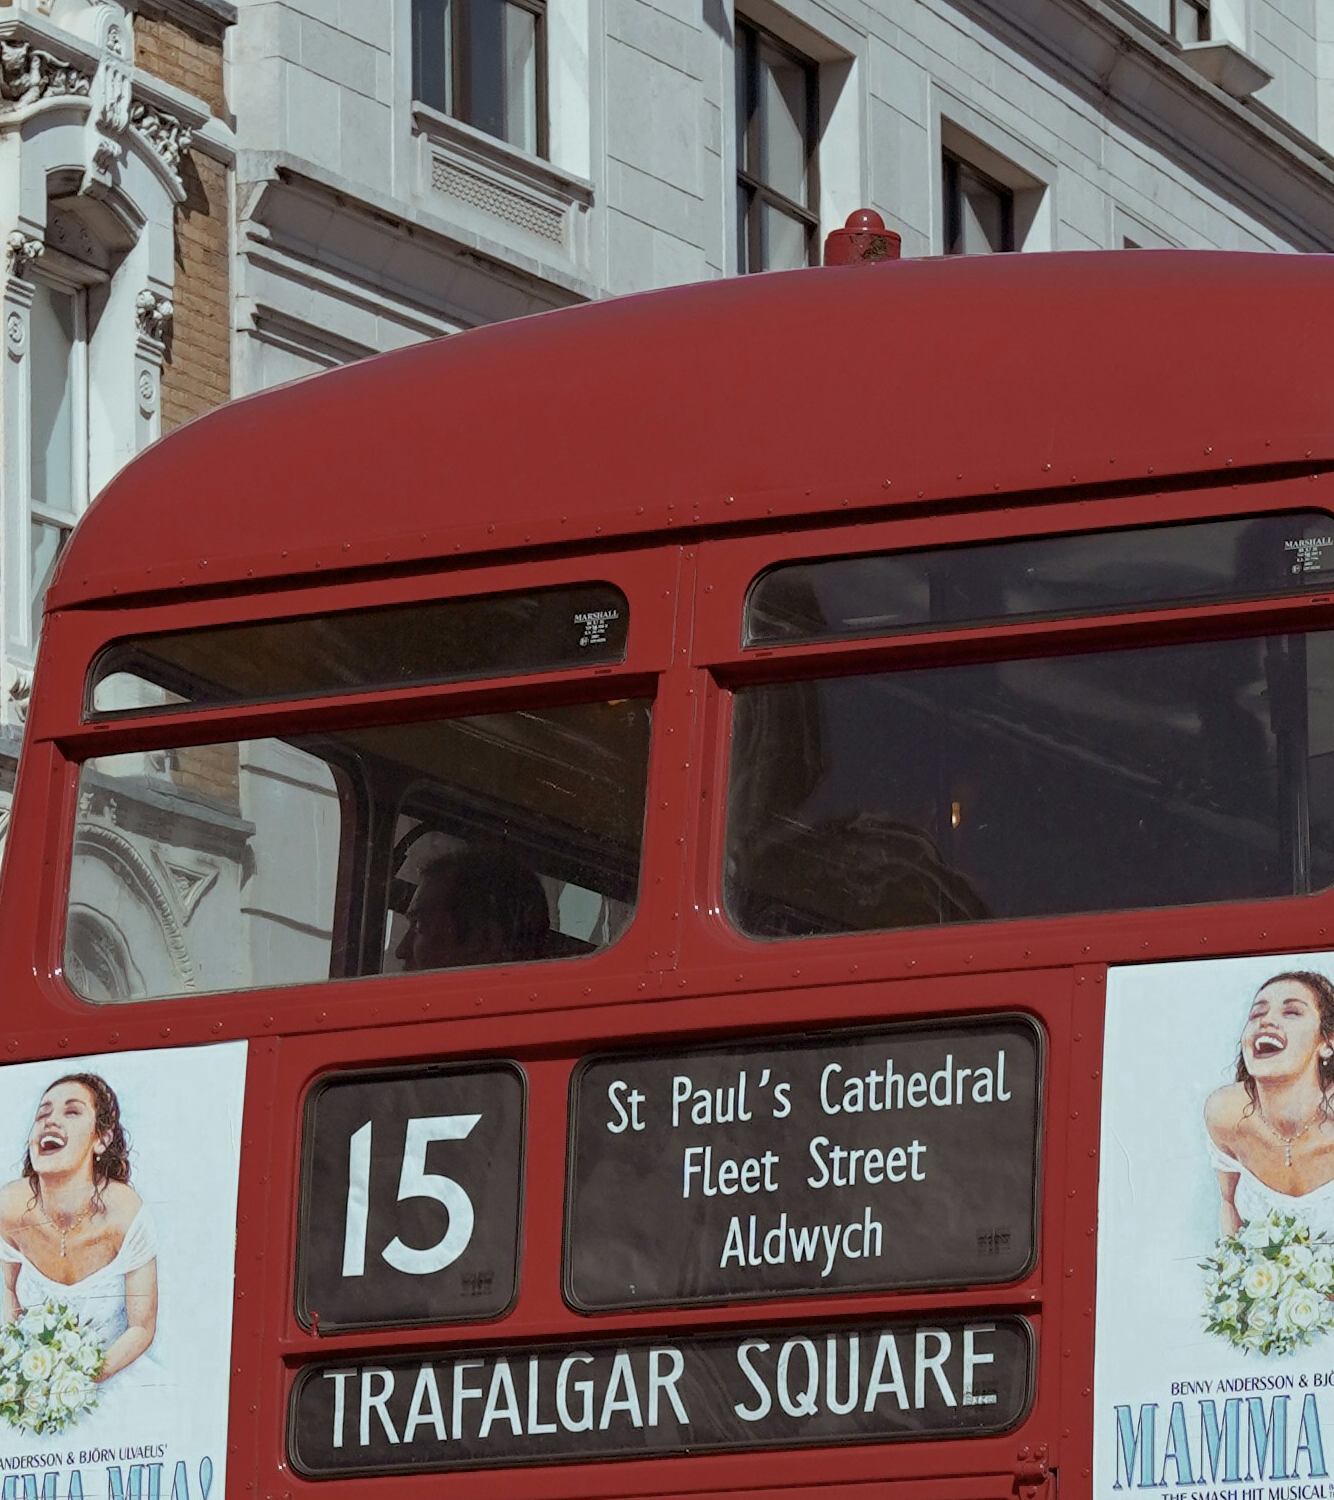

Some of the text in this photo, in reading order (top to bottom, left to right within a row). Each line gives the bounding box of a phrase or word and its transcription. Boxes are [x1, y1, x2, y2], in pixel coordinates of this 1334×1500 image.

[606, 1050, 1012, 1134] St Paul's Cathedral
[342, 1113, 483, 1277] 15
[682, 1136, 927, 1199] Fleet Street
[719, 1206, 883, 1278] Aldwych
[323, 1324, 998, 1449] TRAFALGAR SQUARE
[1170, 1379, 1214, 1396] BENNY
[1216, 1375, 1294, 1394] ANDERSSON
[1298, 1374, 1309, 1388] &
[66, 1451, 76, 1465] &
[79, 1445, 116, 1465] BJÖRN
[1112, 1392, 1329, 1491] MAMMA
